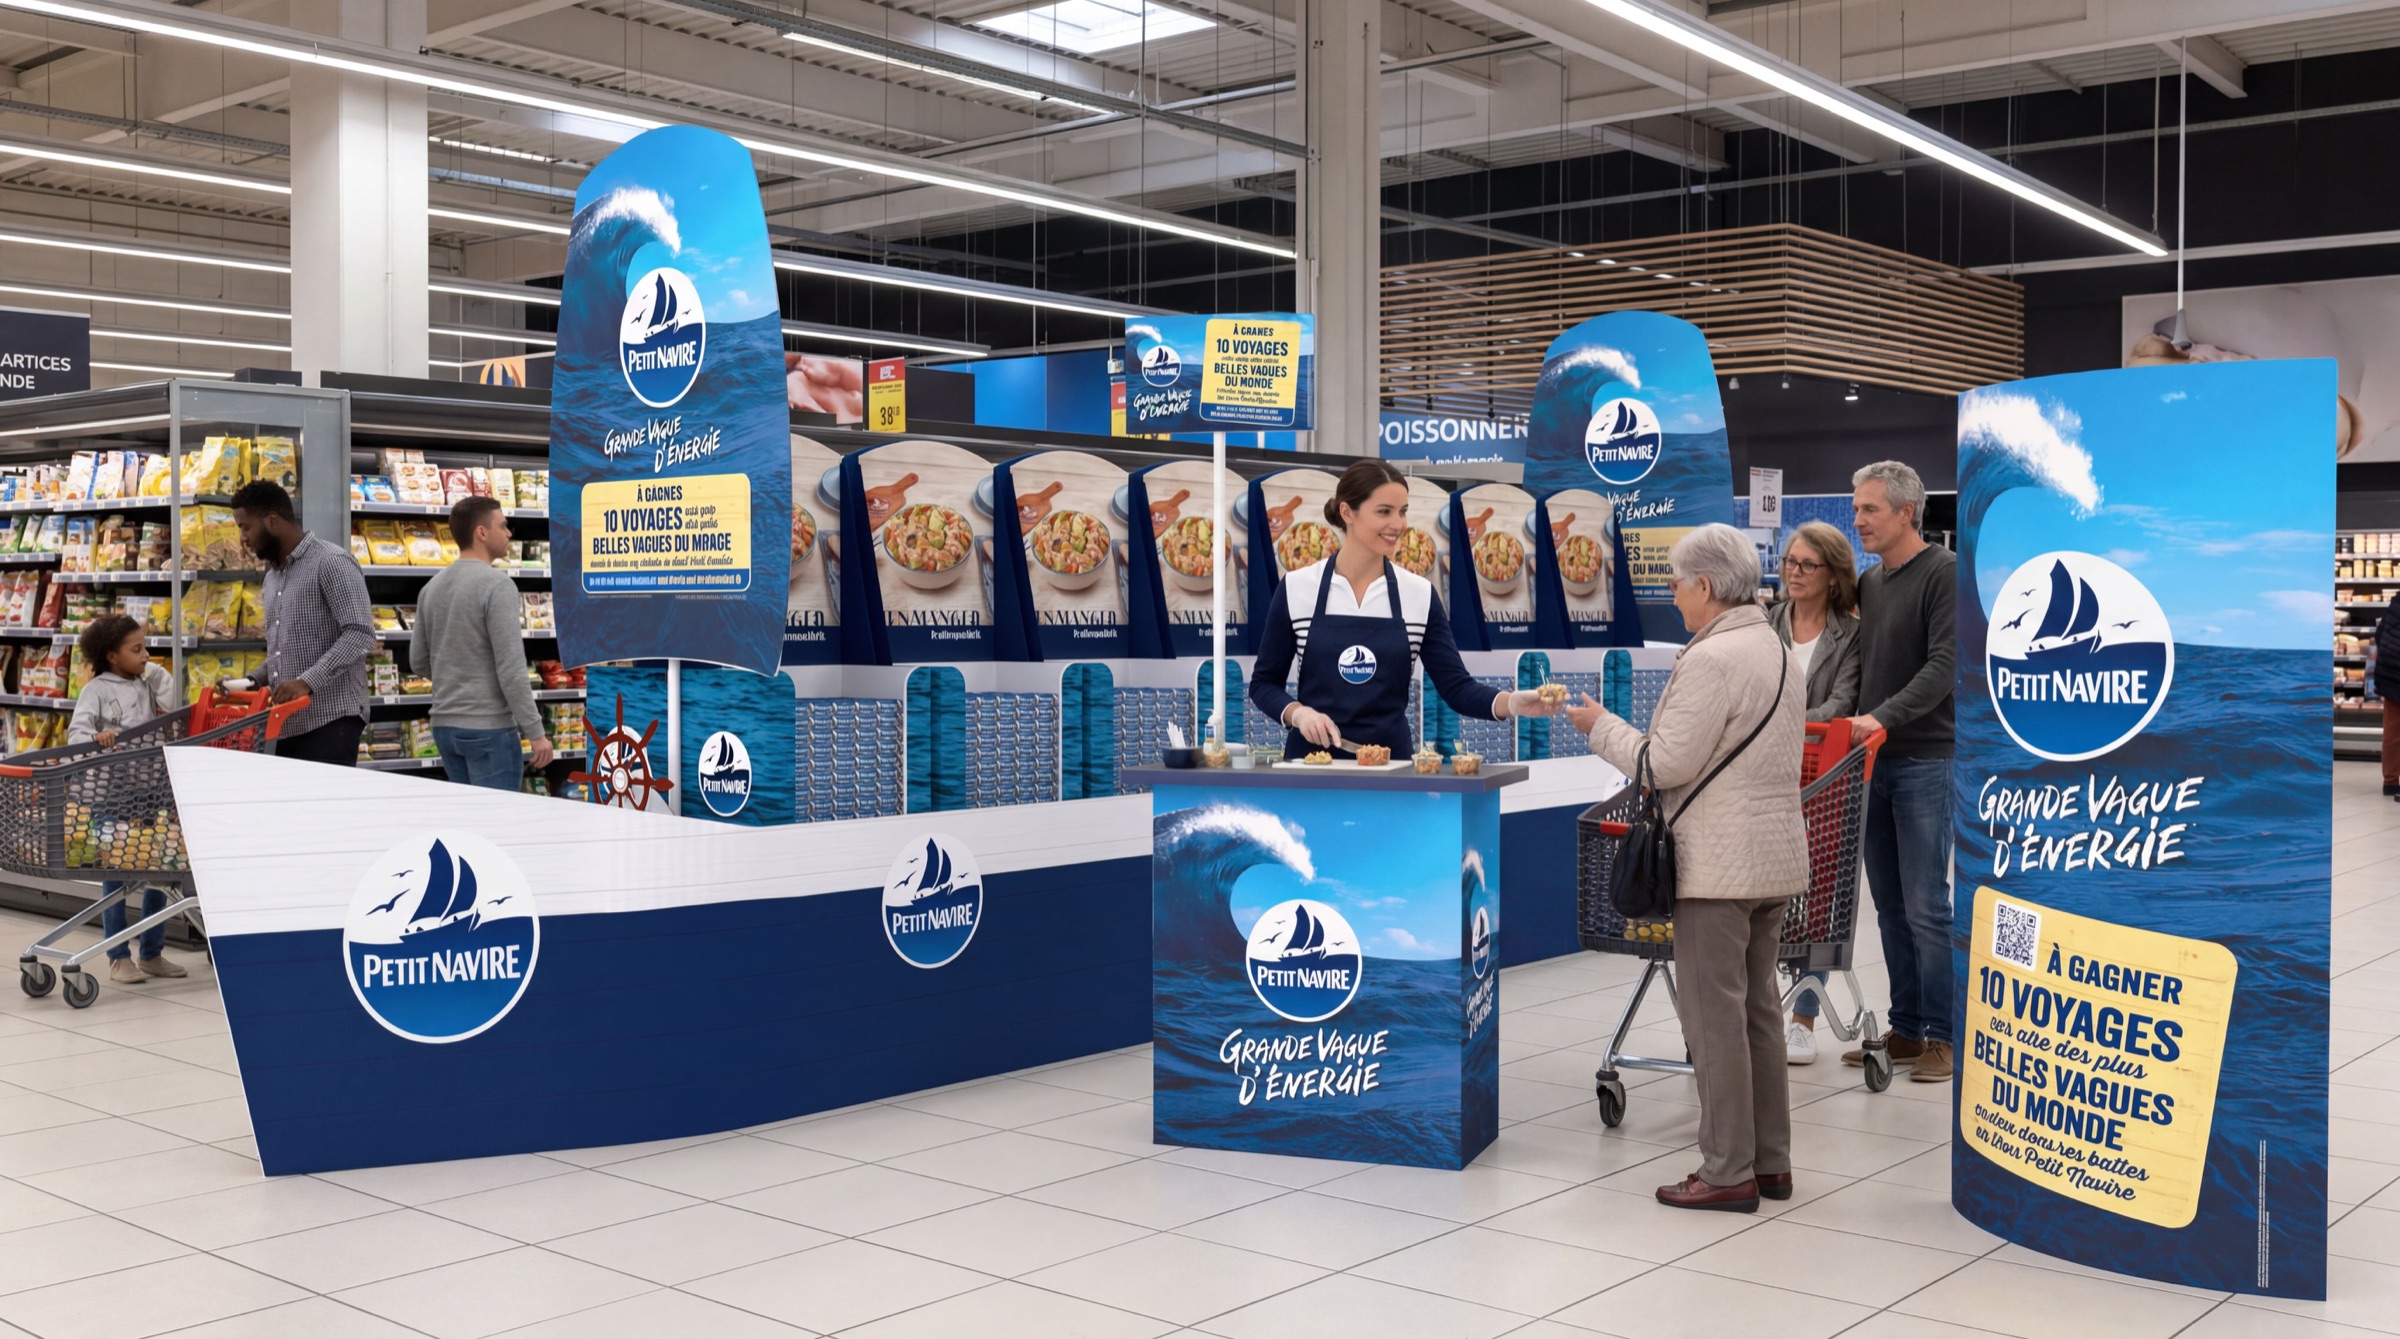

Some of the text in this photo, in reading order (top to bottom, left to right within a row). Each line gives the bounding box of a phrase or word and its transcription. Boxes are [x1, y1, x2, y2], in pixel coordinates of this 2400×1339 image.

[0, 353, 71, 372] ARTICES
[657, 340, 696, 369] NAVIRE
[1217, 338, 1289, 356] 10 VOYAGES
[0, 374, 35, 389] NDE
[1214, 363, 1248, 375] BELLES
[1225, 376, 1273, 389] DU MONDE
[604, 416, 682, 461] GRANDE VAGUE
[1592, 444, 1654, 463] PETIT NAVIRE
[604, 509, 618, 533] 10
[621, 506, 683, 532] VOYAGES
[593, 536, 630, 555] BELLES
[632, 535, 672, 554] VAGUES
[675, 534, 689, 552] DU
[1633, 563, 1646, 574] DU
[1998, 667, 2148, 705] PETIT NAVIRE
[1978, 774, 2205, 838] GRANDE VAGUE
[892, 902, 973, 935] PETIT NAVIRE
[363, 944, 521, 988] PETIT NAVIRE
[1257, 965, 1350, 990] PETIT NAVIRE
[2047, 942, 2183, 1005] À GAGNER
[1980, 966, 2183, 1062] 10 VOYAGES
[1219, 1027, 1389, 1076] GRANDE VAGUE
[2054, 1040, 2092, 1064] des
[2090, 1054, 2148, 1079] plus
[1974, 1030, 2175, 1126] BELLES VAGUES
[1992, 1075, 2126, 1152] DU MONDE
[2024, 1148, 2065, 1177] Petit
[2066, 1165, 2137, 1202] Navire
